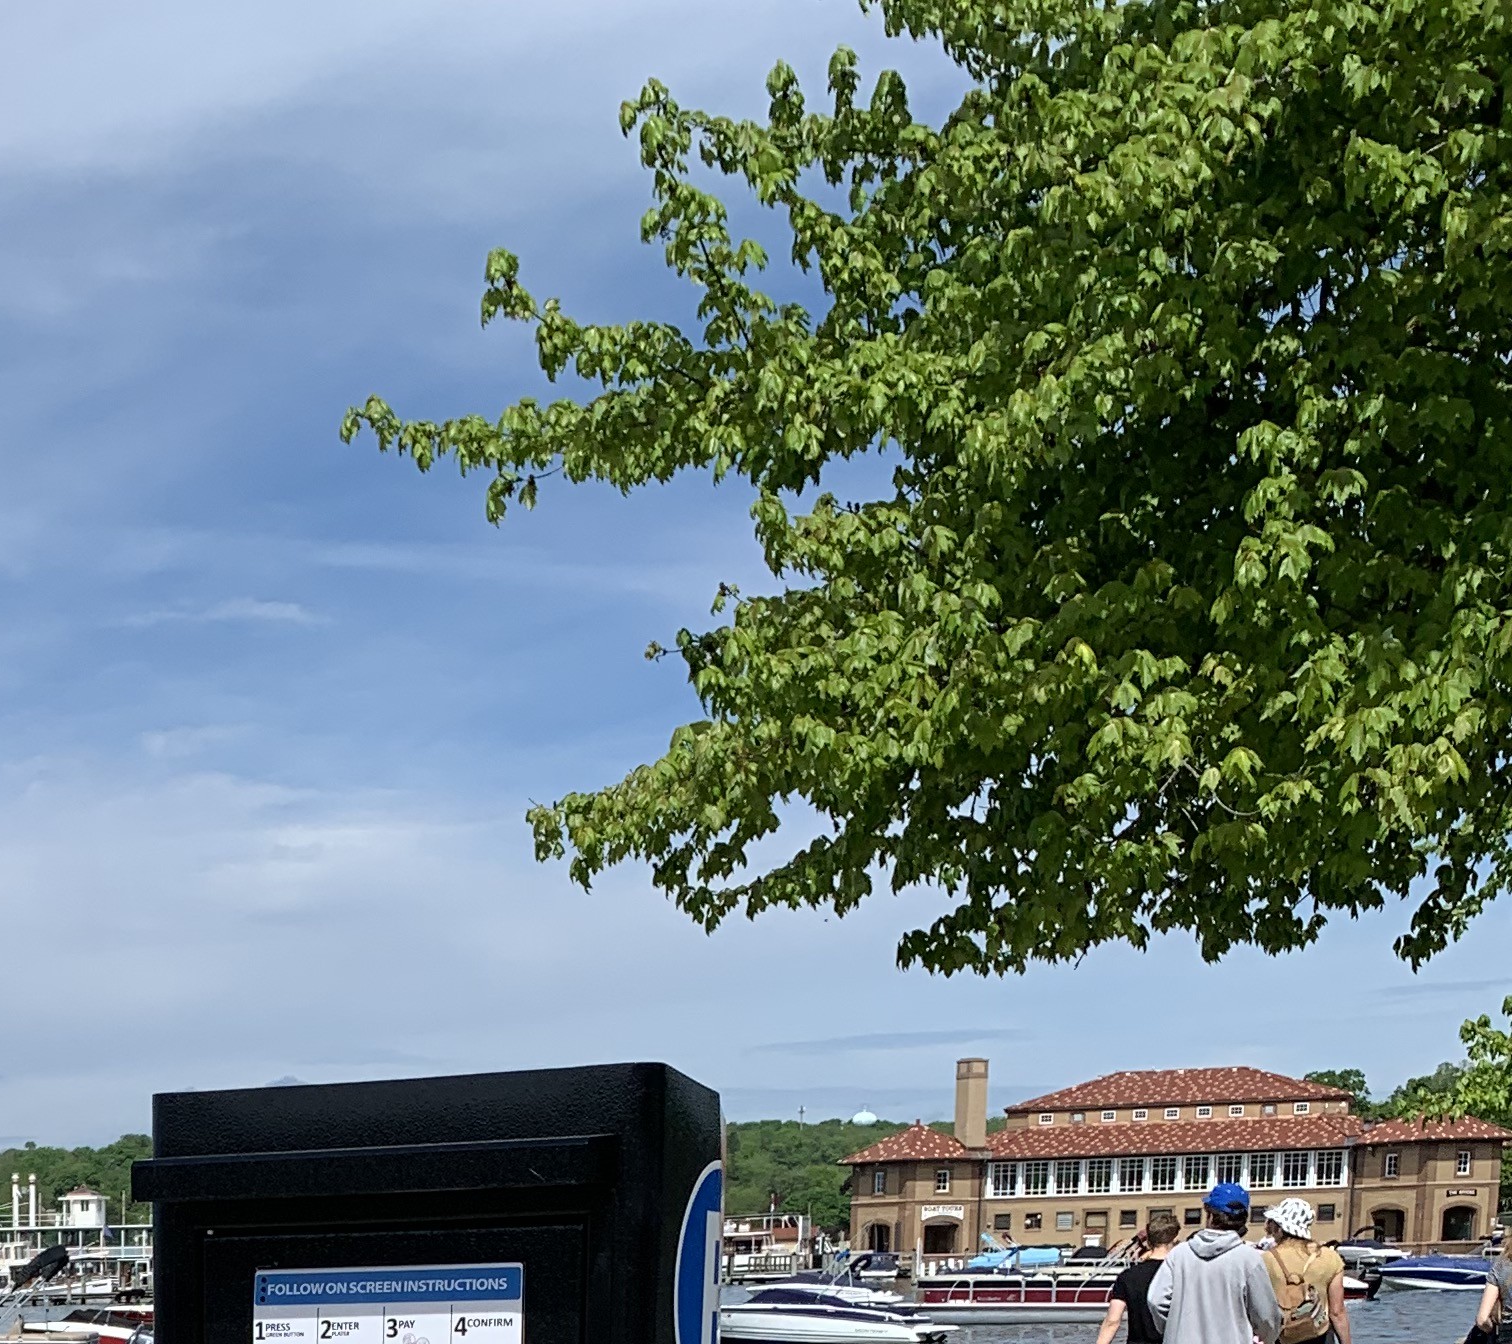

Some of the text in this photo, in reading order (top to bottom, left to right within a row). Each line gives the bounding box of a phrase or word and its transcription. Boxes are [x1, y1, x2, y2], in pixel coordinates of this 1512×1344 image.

[267, 1277, 508, 1296] FOLLOW ON SCREEN INSTRUCTIONS
[255, 1321, 291, 1341] 1 PRESS
[320, 1319, 360, 1339] 2 ENTER
[386, 1318, 416, 1338] 3 PAY
[454, 1316, 514, 1337] 4 CONFIRM
